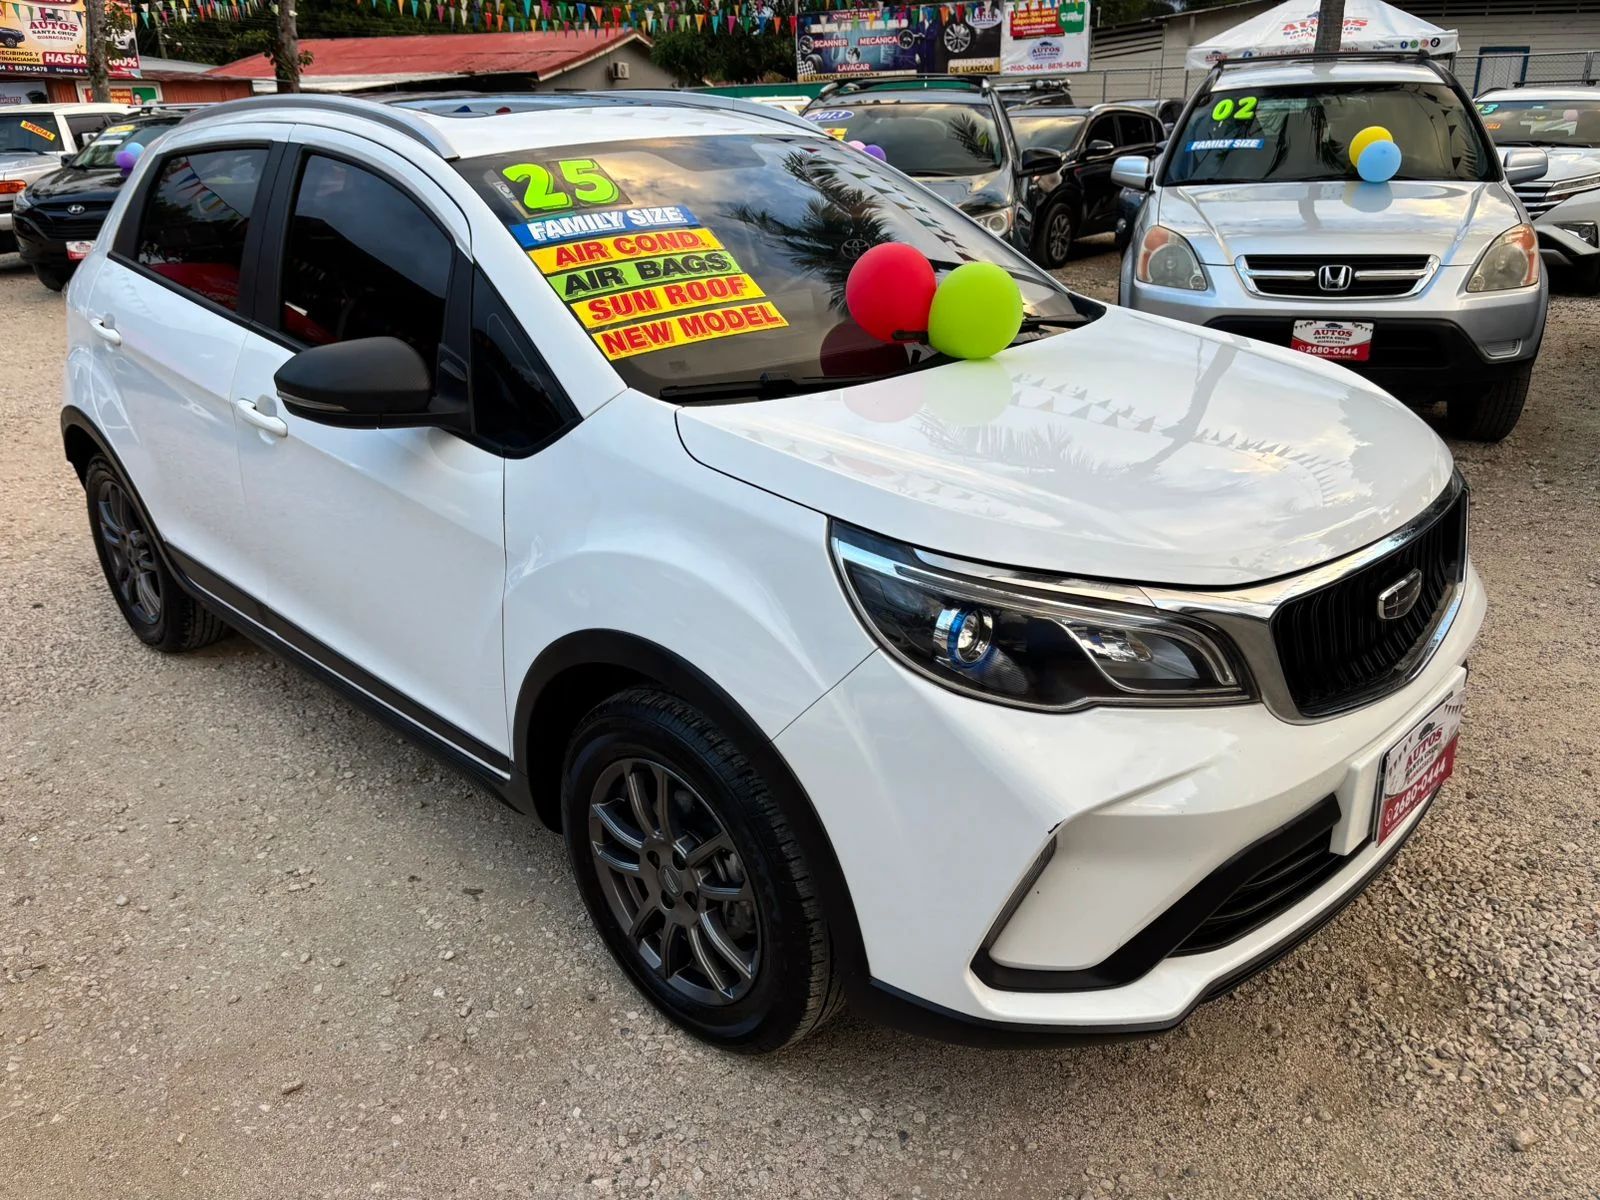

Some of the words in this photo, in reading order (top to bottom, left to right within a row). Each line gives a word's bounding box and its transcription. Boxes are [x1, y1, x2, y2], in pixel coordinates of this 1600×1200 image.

[30, 21, 79, 32] AUTOS
[814, 39, 848, 48] SCANNER
[859, 36, 898, 45] MECÁNICA
[1032, 46, 1061, 54] AUTOS
[45, 53, 87, 65] HASTA
[837, 63, 870, 72] LAVACAR
[962, 64, 993, 73] LLANTAS
[1212, 96, 1258, 121] 02
[22, 121, 53, 139] SPECIAL
[1191, 140, 1232, 151] FAMILY
[1232, 139, 1260, 149] SIZE
[502, 158, 621, 210] 25
[526, 210, 624, 242] FAMILY
[630, 206, 688, 227] SIZE
[555, 240, 610, 268] AIR
[615, 230, 709, 256] COND.
[564, 266, 630, 296] AIR
[635, 252, 733, 282] BAGS
[587, 289, 663, 323] SUN
[667, 276, 748, 307] ROOF
[599, 320, 677, 355] NEW
[680, 304, 781, 339] MODEL
[1312, 329, 1353, 338] AUTOS
[1305, 345, 1358, 355] 2680-0444
[1404, 727, 1443, 772] AUTOS
[1392, 756, 1447, 821] 2680-0444
